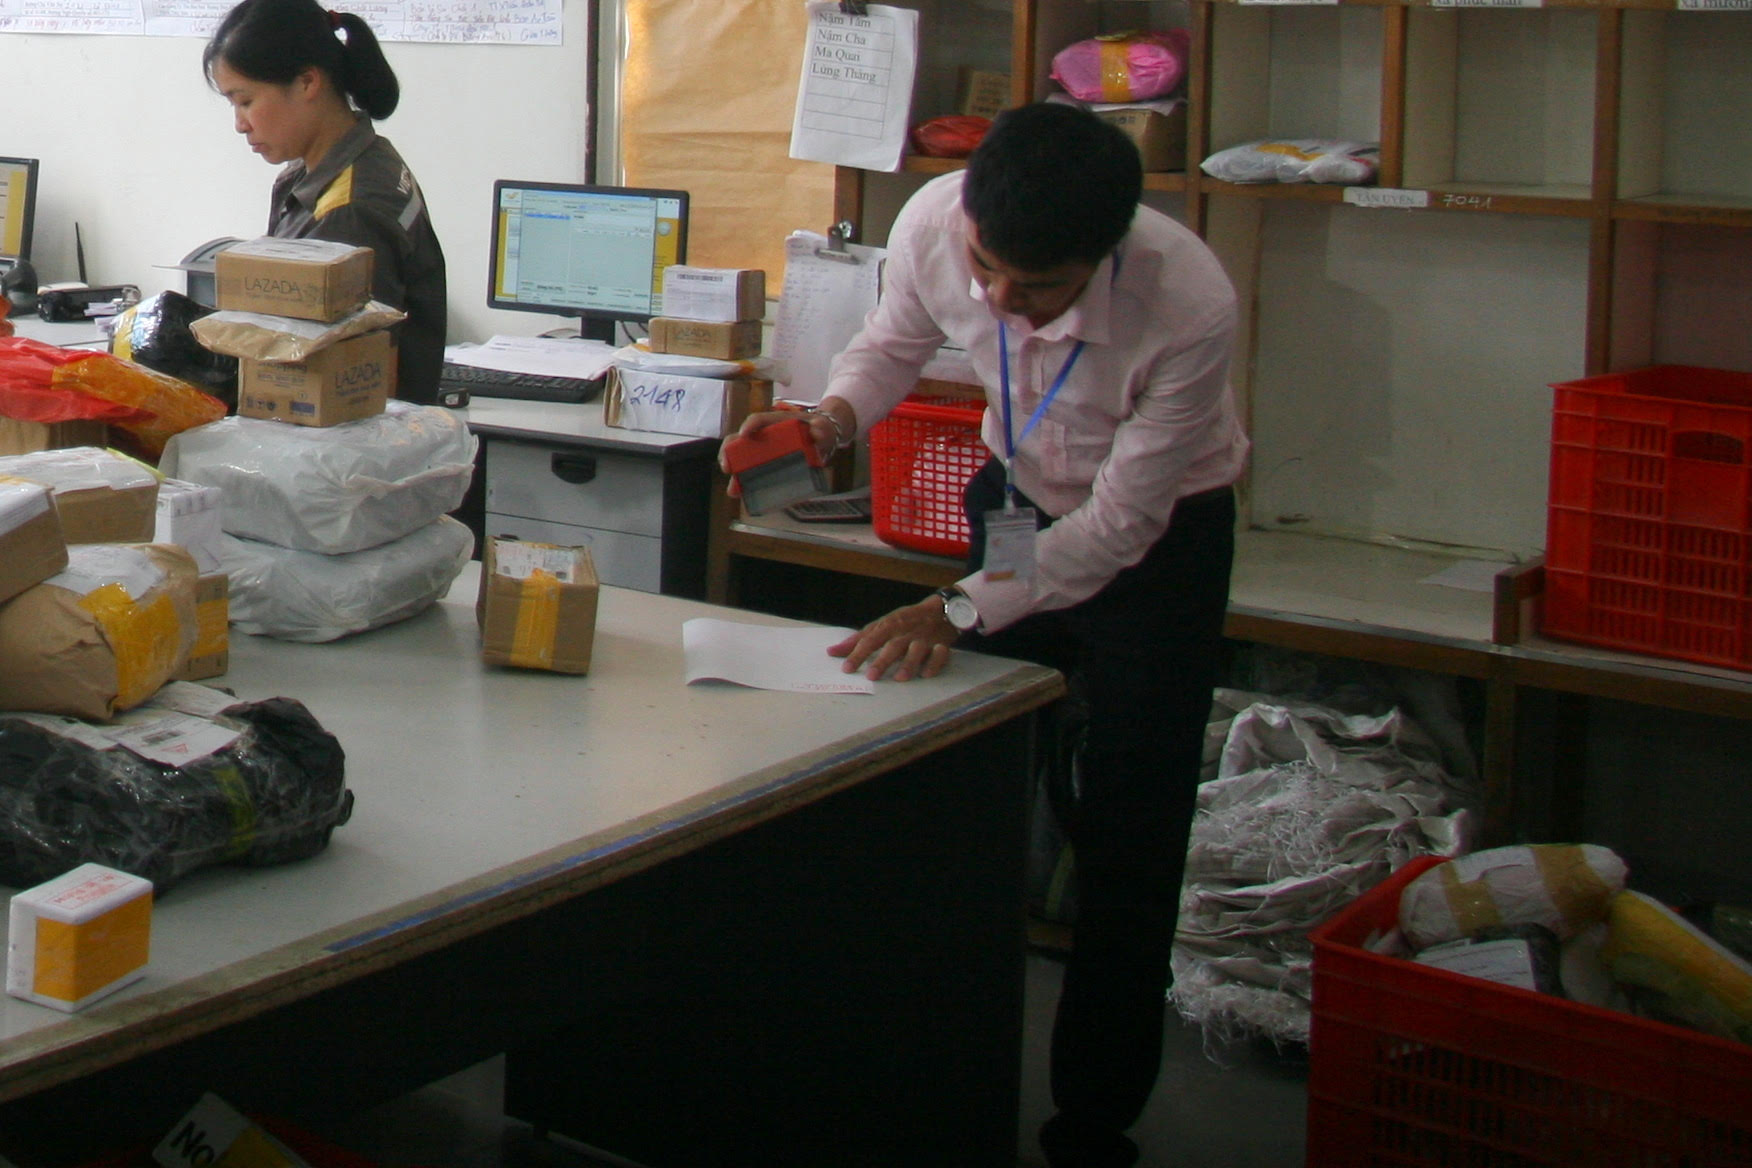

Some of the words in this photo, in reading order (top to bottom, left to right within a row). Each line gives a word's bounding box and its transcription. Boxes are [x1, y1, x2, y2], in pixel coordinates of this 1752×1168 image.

[845, 32, 866, 46] Cha
[244, 277, 300, 294] LAZADA
[335, 363, 381, 389] LAZADA
